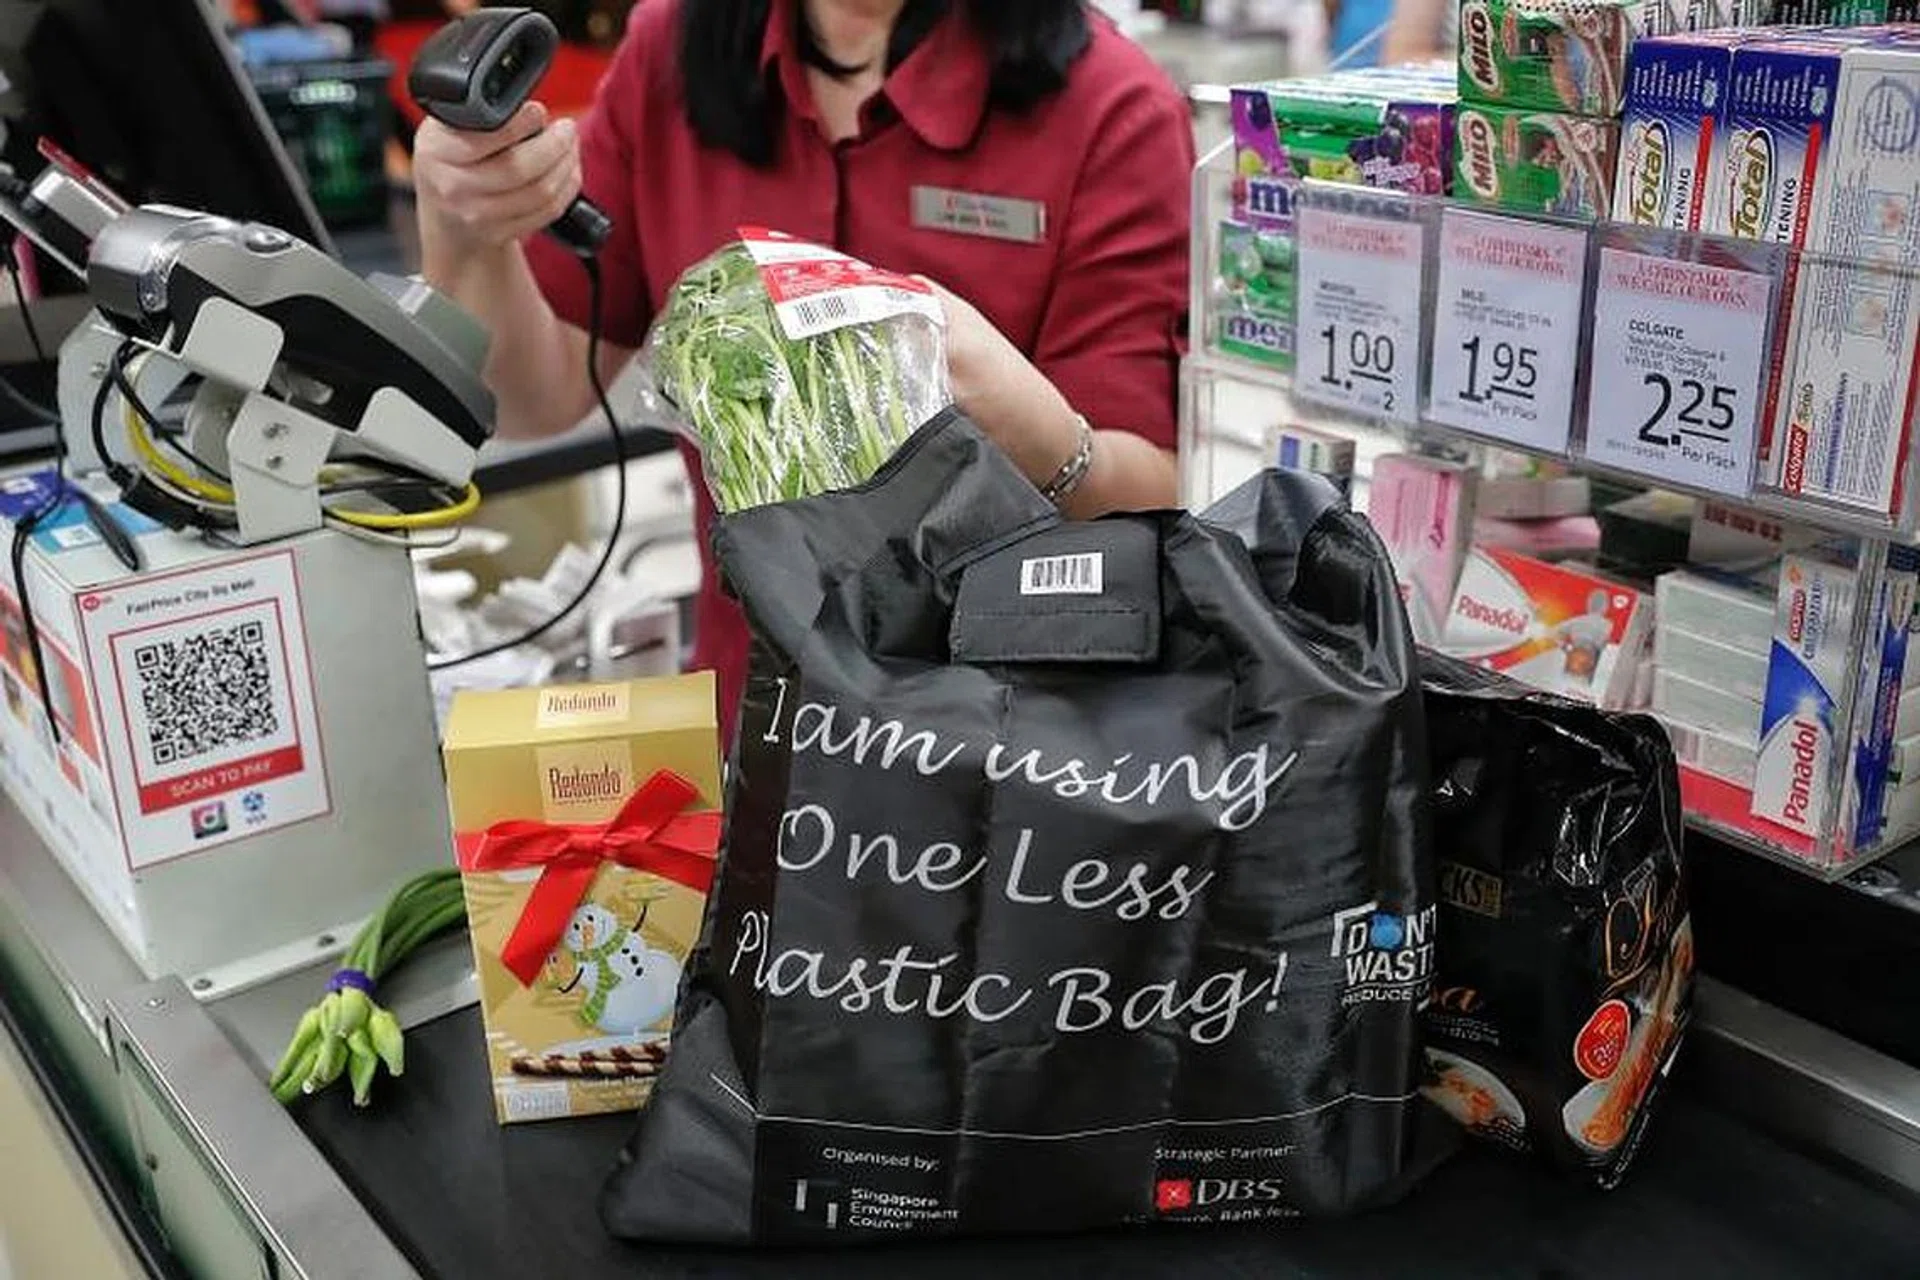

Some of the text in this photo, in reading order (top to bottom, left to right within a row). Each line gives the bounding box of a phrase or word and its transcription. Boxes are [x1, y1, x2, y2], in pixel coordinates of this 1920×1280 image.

[1470, 11, 1494, 85] MILO
[1469, 119, 1493, 192] MILO
[1629, 319, 1685, 340] COLGATE
[1456, 594, 1530, 635] Panadol
[169, 775, 216, 797] SCAN
[217, 769, 241, 785] TO
[548, 762, 622, 800] Redondo
[791, 701, 965, 776] am
[984, 739, 1298, 831] using
[1783, 718, 1819, 825] Panadol
[776, 803, 1214, 921] One Less
[729, 909, 1288, 1044] Plastic Bag!
[822, 1147, 940, 1172] Organised by:
[1153, 1146, 1227, 1163] Strategic
[850, 1187, 940, 1208] Singapore
[850, 1200, 960, 1220] Environment
[1197, 1178, 1284, 1206] DBS
